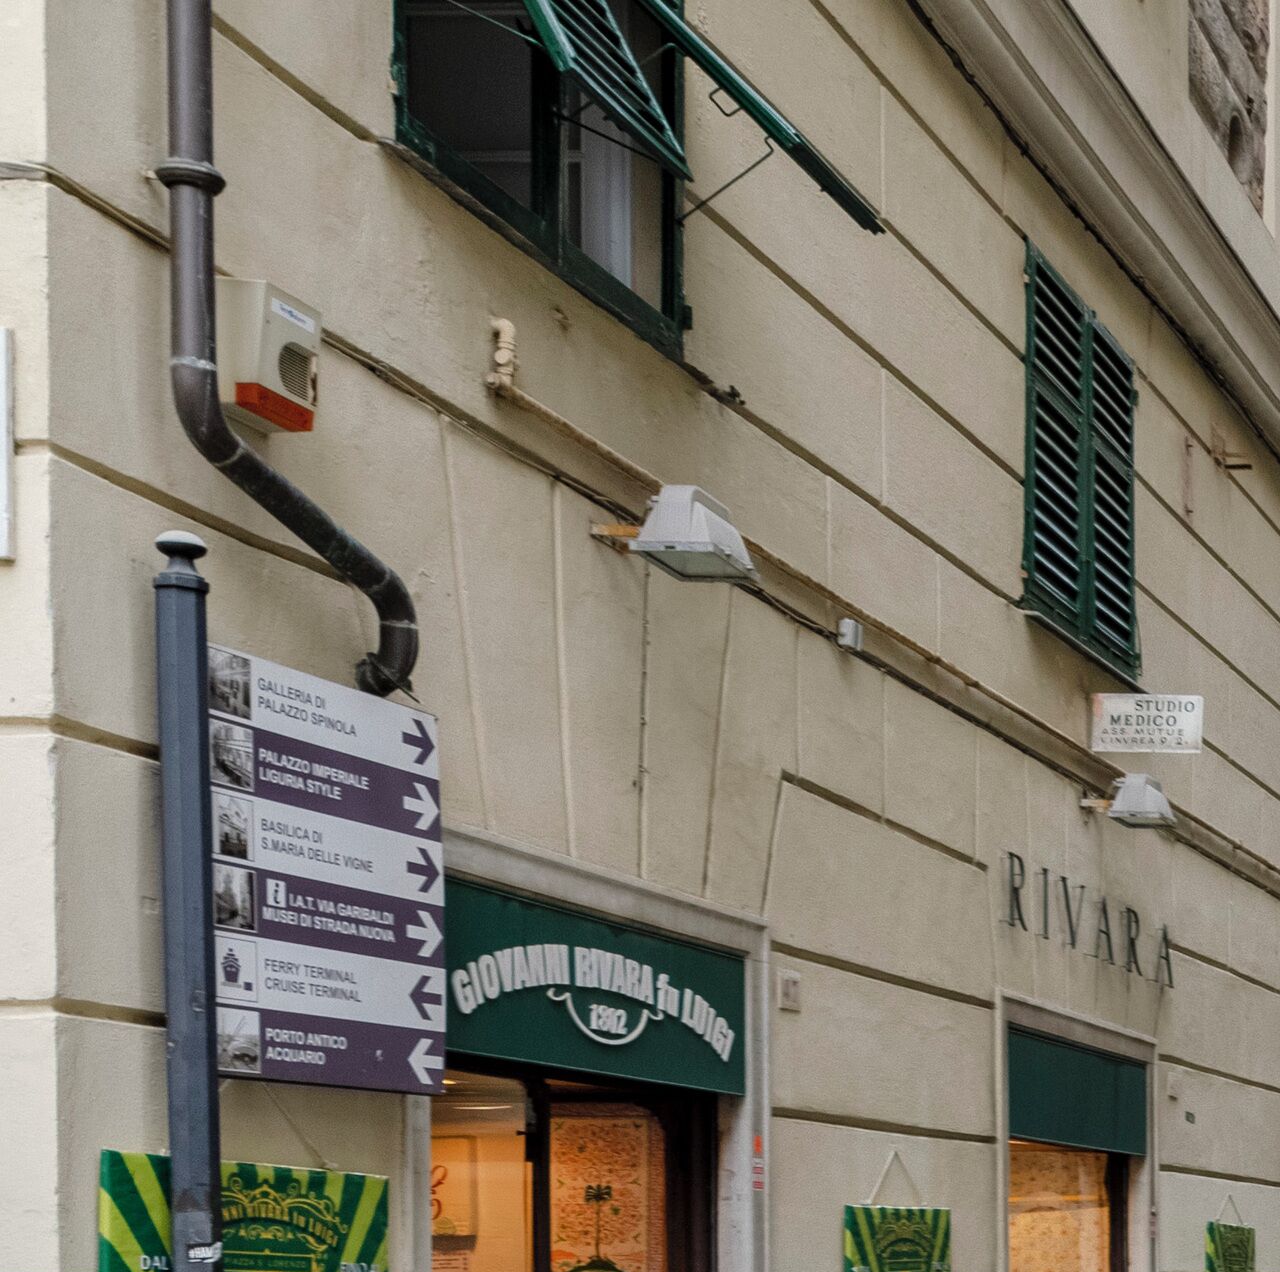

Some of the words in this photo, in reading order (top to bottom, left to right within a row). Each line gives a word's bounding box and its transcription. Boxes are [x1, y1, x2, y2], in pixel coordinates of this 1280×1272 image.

[257, 677, 313, 704] GALLERIA
[315, 695, 326, 710] DI
[1134, 699, 1196, 713] STUDIO
[257, 695, 308, 722] PALAZZO
[310, 712, 357, 737] SPINOLA
[1109, 714, 1178, 727] MEDICO
[258, 747, 311, 774] PALAZZO
[311, 762, 370, 791] IMPERIALE
[258, 766, 306, 792] LIGURIA
[306, 778, 342, 801] STYLE
[260, 818, 311, 843] BASILICA
[312, 830, 323, 844] DI
[308, 846, 341, 866] DELLE
[342, 855, 375, 874] VIGNE
[261, 906, 299, 926] MUSEI
[300, 912, 313, 928] DI
[313, 916, 358, 937] STRADA
[357, 924, 397, 943] NUOVA
[316, 898, 336, 915] VIA
[336, 902, 396, 926] GARIBALDI
[998, 850, 1176, 989] RIVARA
[263, 958, 301, 978] FERRY
[303, 964, 358, 985] TERMINAL
[264, 976, 306, 995] CRUISE
[308, 984, 363, 1003] TERMINAL
[451, 943, 571, 1015] GIOVANNI
[574, 945, 655, 1006] RIVARA
[680, 987, 736, 1063] LUIGI
[264, 1027, 306, 1045] PORTO
[306, 1033, 348, 1050] ANTICO
[265, 1046, 327, 1066] ACQUARIO
[140, 1254, 171, 1270] DAL
